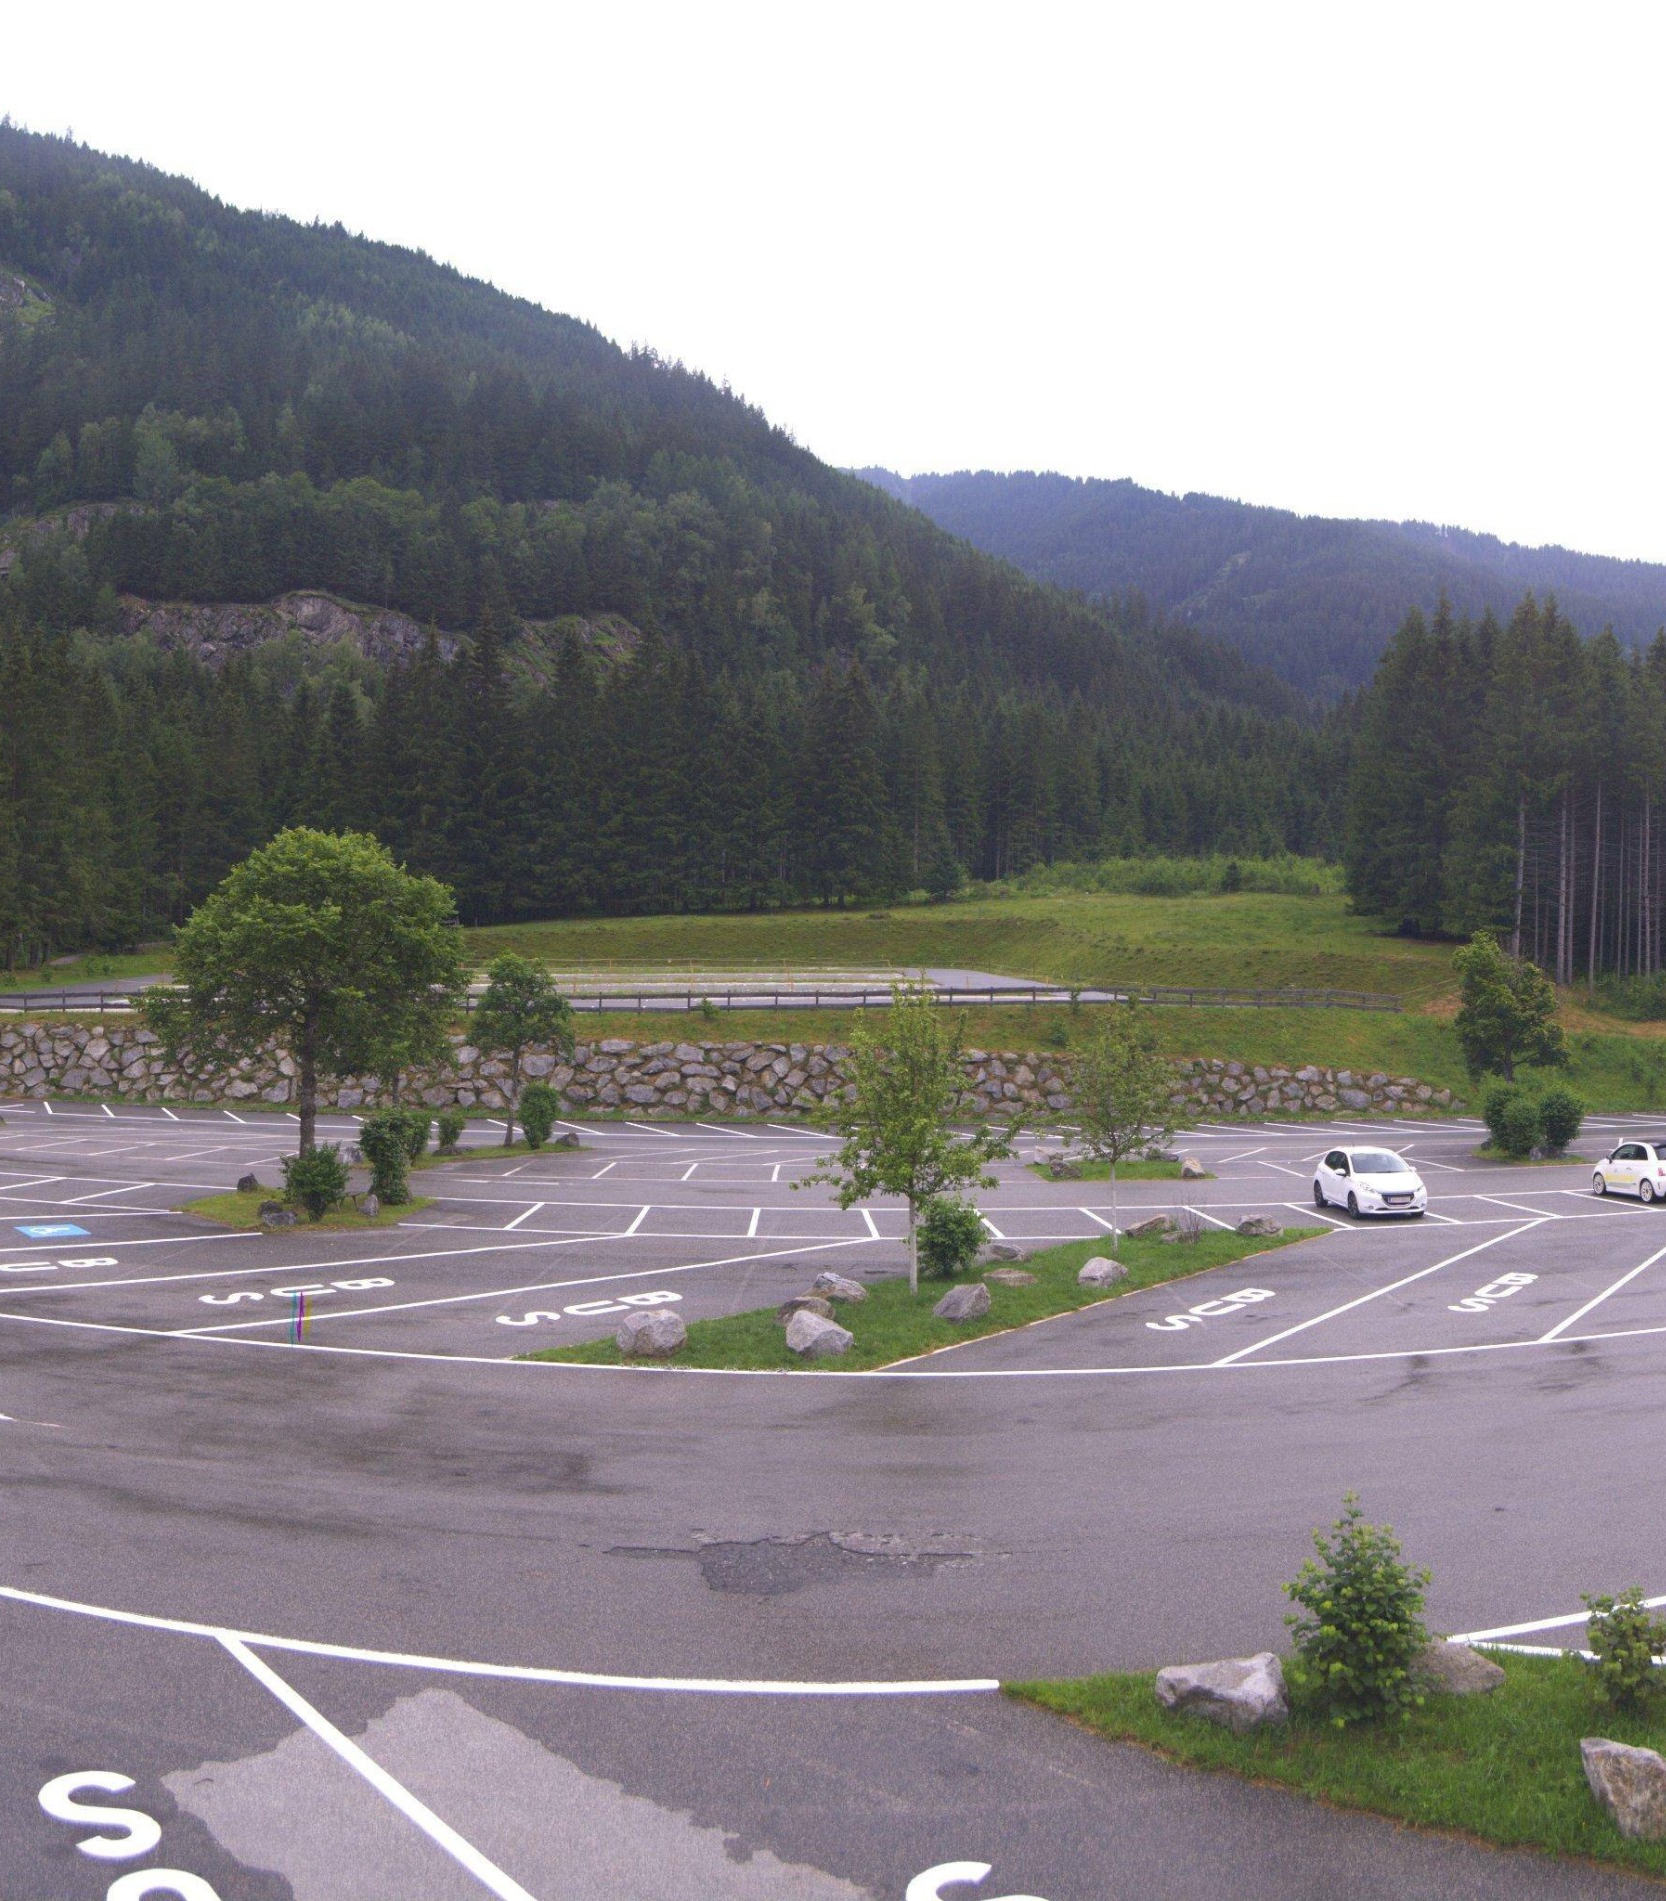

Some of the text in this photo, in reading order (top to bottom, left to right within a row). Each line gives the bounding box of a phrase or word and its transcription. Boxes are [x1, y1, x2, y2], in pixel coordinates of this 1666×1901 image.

[198, 1277, 396, 1305] BUS
[495, 1290, 683, 1327] BUS
[1145, 1287, 1276, 1331] BUS
[1448, 1272, 1539, 1313] BUS
